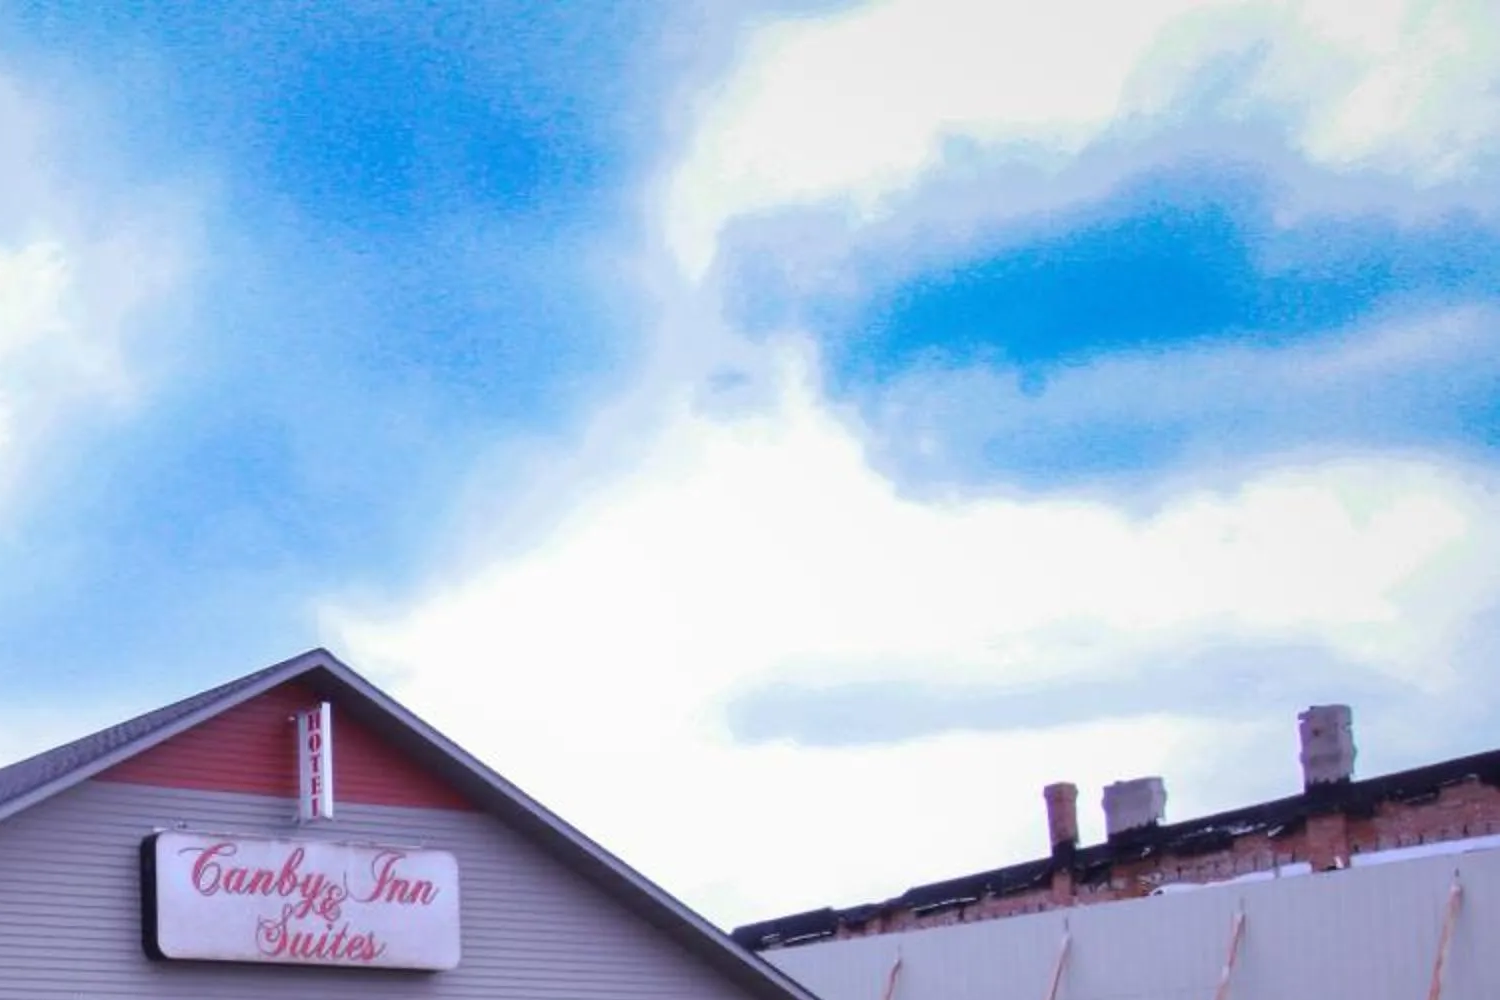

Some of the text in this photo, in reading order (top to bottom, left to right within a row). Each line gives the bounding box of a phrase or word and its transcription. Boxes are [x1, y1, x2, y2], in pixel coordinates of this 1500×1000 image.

[178, 843, 325, 919] Canby
[350, 850, 440, 905] Inn
[255, 903, 387, 964] Suites
